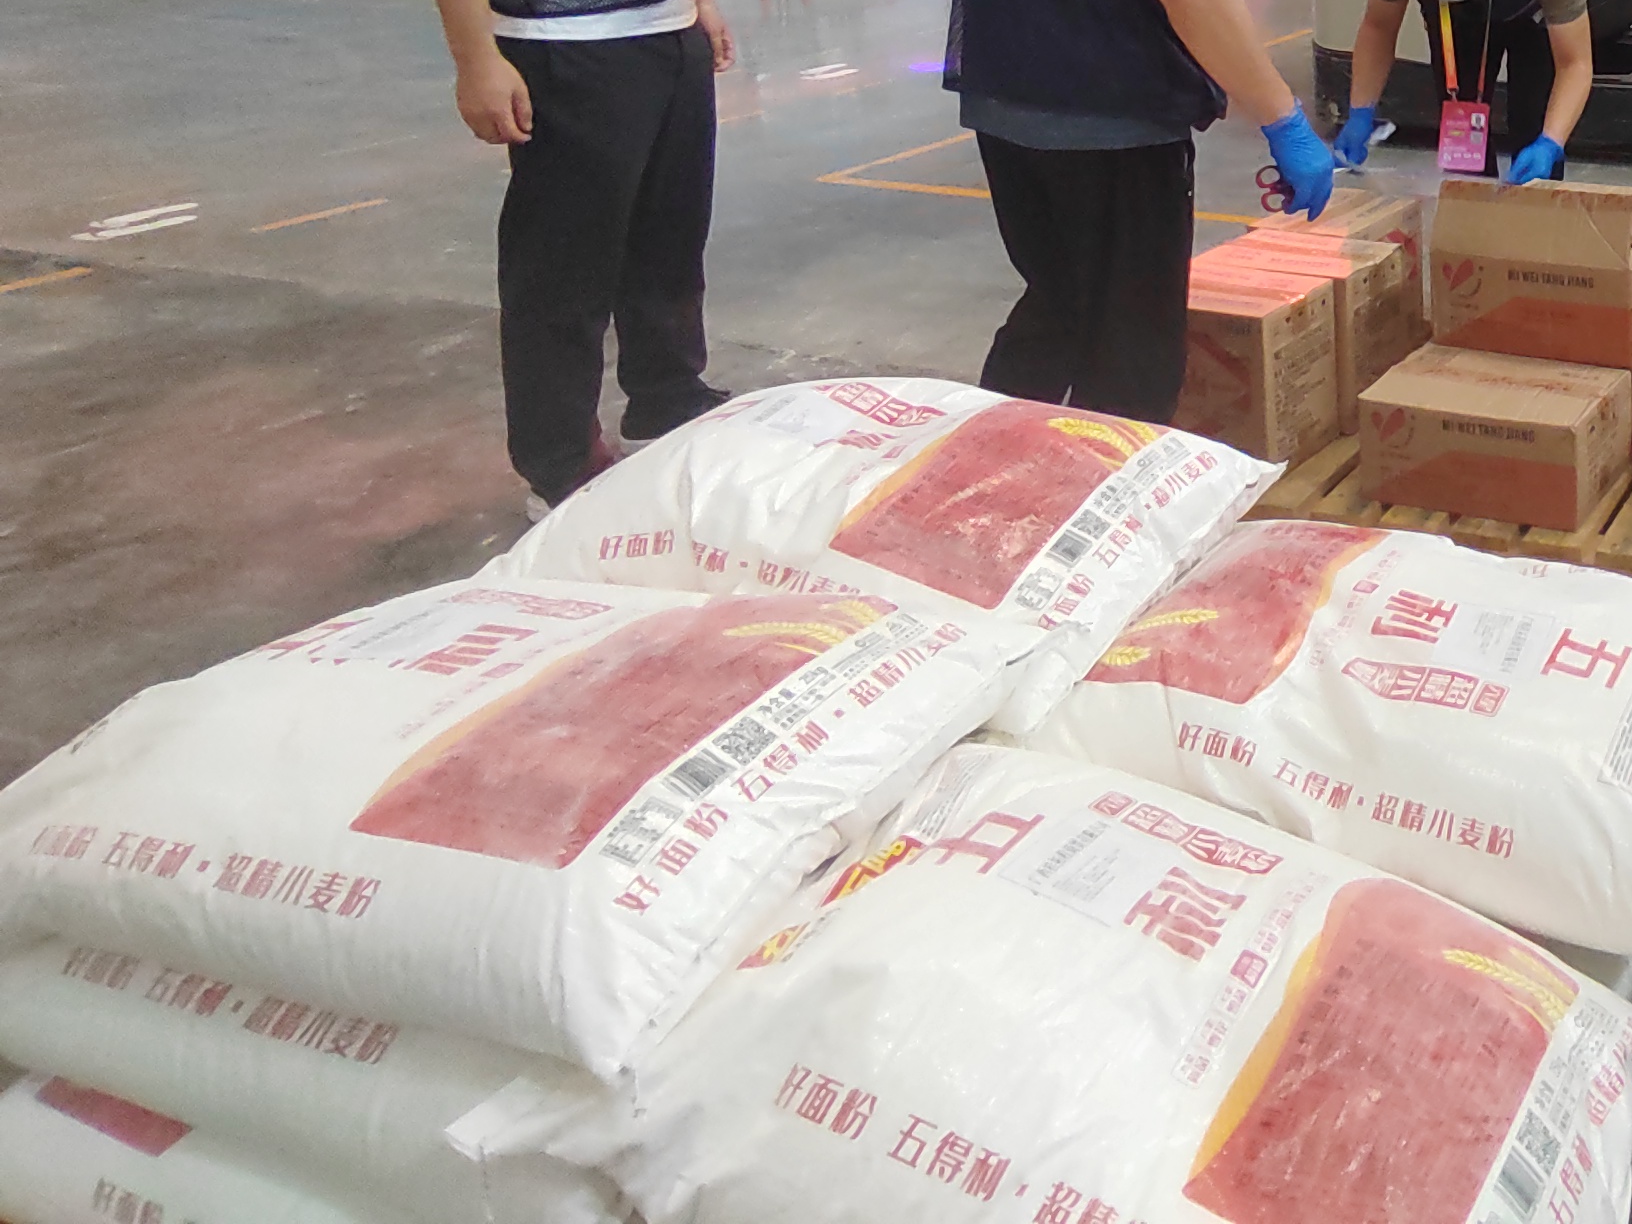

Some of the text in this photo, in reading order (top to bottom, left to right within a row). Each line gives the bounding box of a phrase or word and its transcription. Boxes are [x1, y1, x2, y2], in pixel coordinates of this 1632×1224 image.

[598, 528, 676, 560] 好面粉
[1178, 721, 1516, 860] 好面粉 五得利·超精小麦粉
[101, 830, 382, 919] 五得利·超精小麦粉
[613, 801, 729, 916] 好面粉
[773, 1062, 878, 1140] 好面粉
